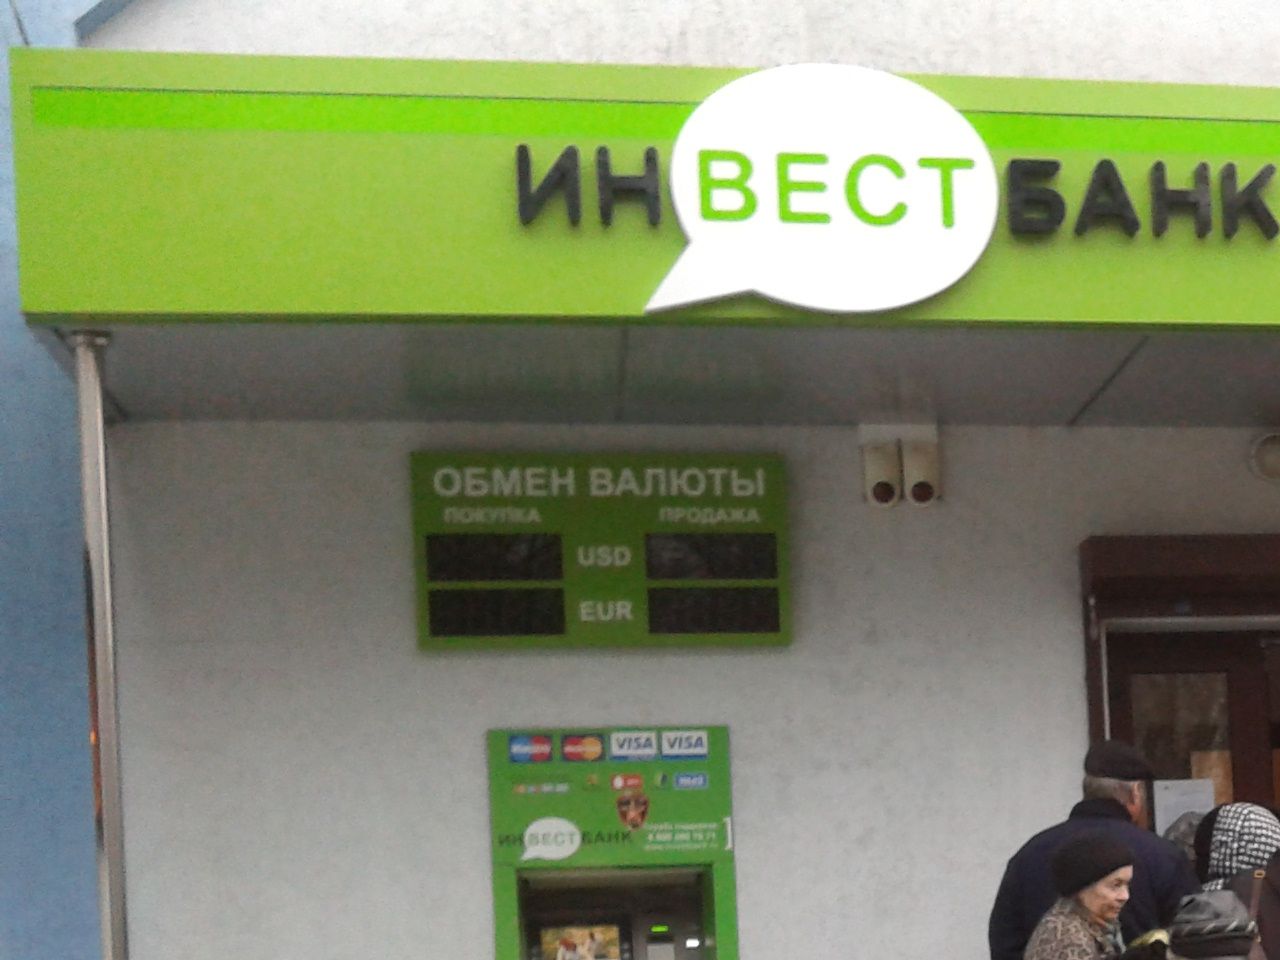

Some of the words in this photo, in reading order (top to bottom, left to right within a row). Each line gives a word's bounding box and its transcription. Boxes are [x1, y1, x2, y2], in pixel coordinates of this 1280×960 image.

[433, 466, 576, 498] ОБМЕН
[588, 467, 765, 498] ВАЛЮТЫ
[443, 507, 541, 524] ПОКУПКА
[658, 506, 761, 524] ПРОДАЖА
[577, 546, 632, 567] USD
[579, 601, 633, 622] EUR
[616, 737, 654, 750] VISA
[667, 736, 704, 749] VISA
